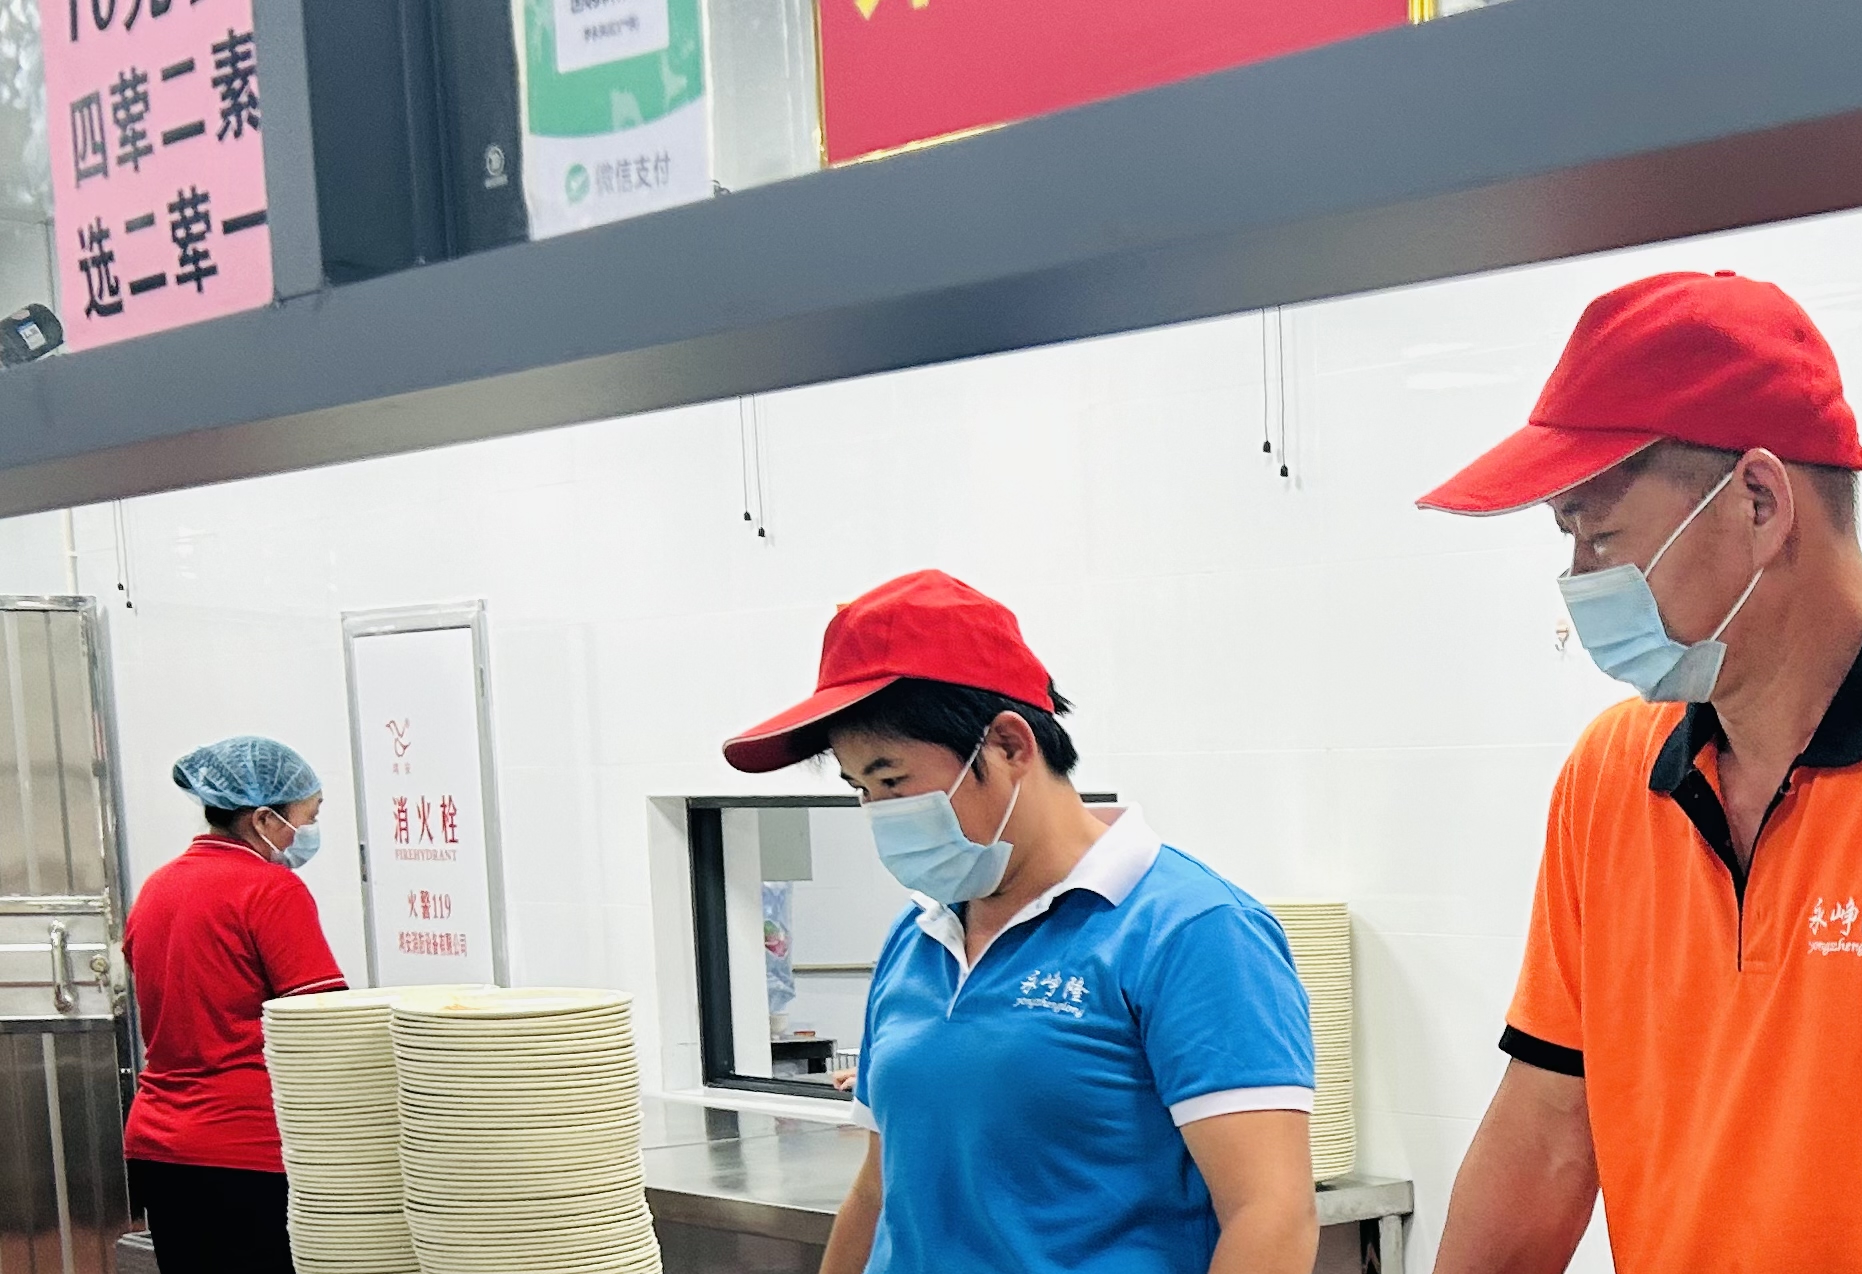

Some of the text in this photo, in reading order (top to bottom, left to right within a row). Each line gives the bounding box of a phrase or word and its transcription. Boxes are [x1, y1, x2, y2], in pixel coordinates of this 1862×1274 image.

[70, 28, 260, 189] 四荤二素
[596, 151, 670, 194] 微信支付
[78, 185, 267, 319] 选二荤一
[392, 795, 459, 844] 消火栓
[395, 848, 457, 861] FIREHYDRANT
[408, 890, 452, 920] 火警119
